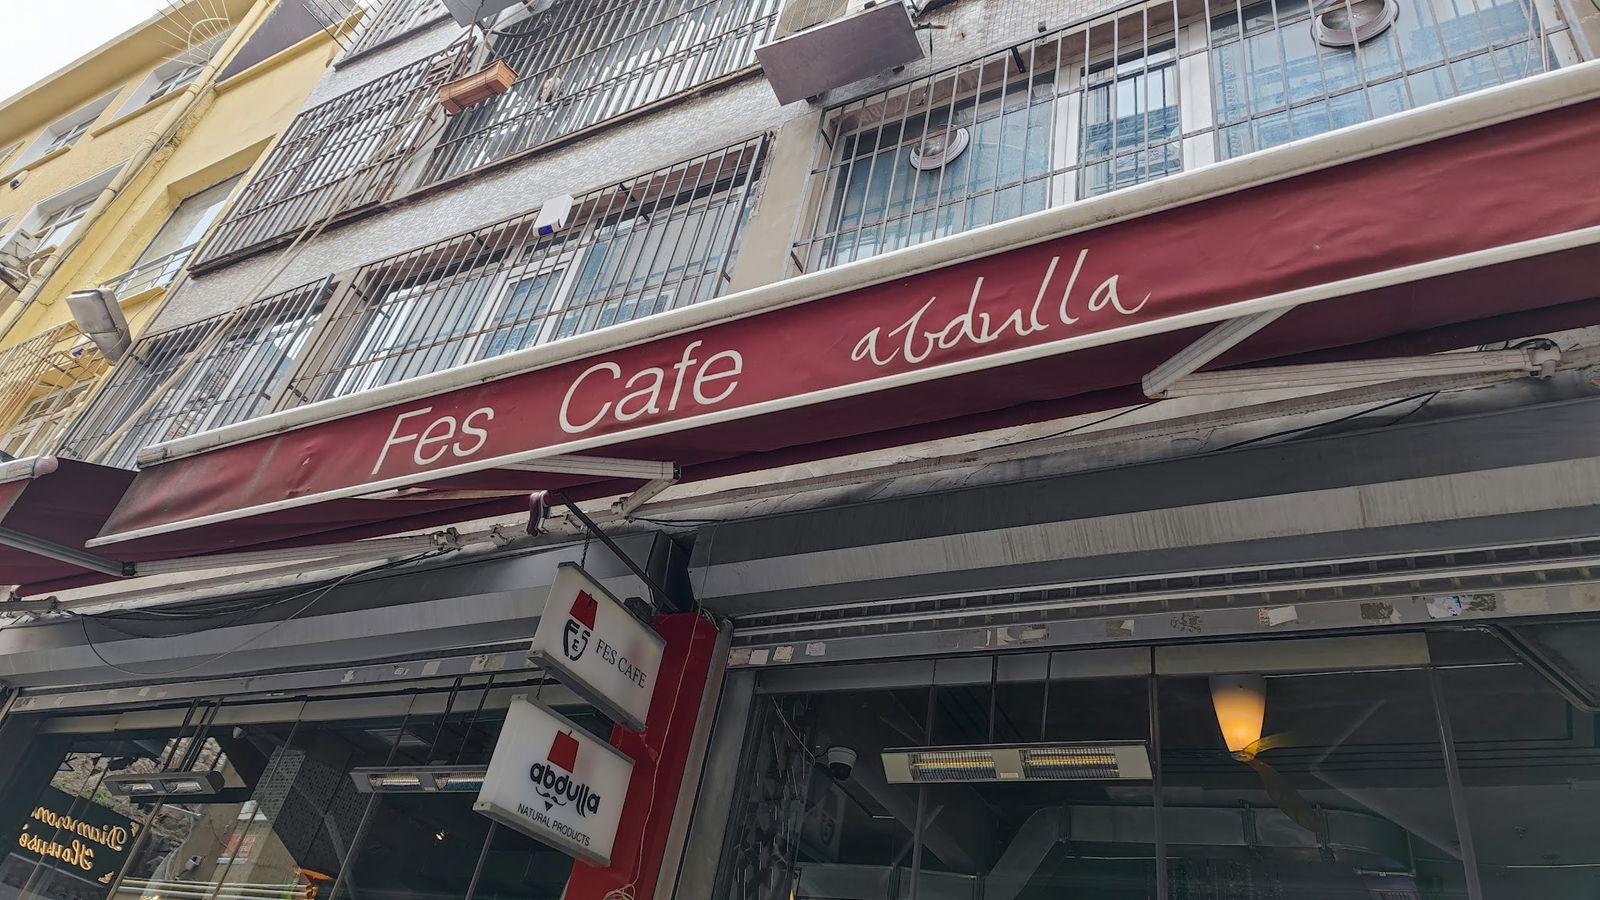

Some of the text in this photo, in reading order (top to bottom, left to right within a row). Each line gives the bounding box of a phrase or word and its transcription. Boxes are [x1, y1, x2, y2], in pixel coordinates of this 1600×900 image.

[371, 248, 1152, 476] Fes Cafe abdulla
[595, 639, 647, 688] FES CAFE
[529, 762, 601, 818] abdulla
[517, 803, 591, 846] NATURAL PRODUCTS
